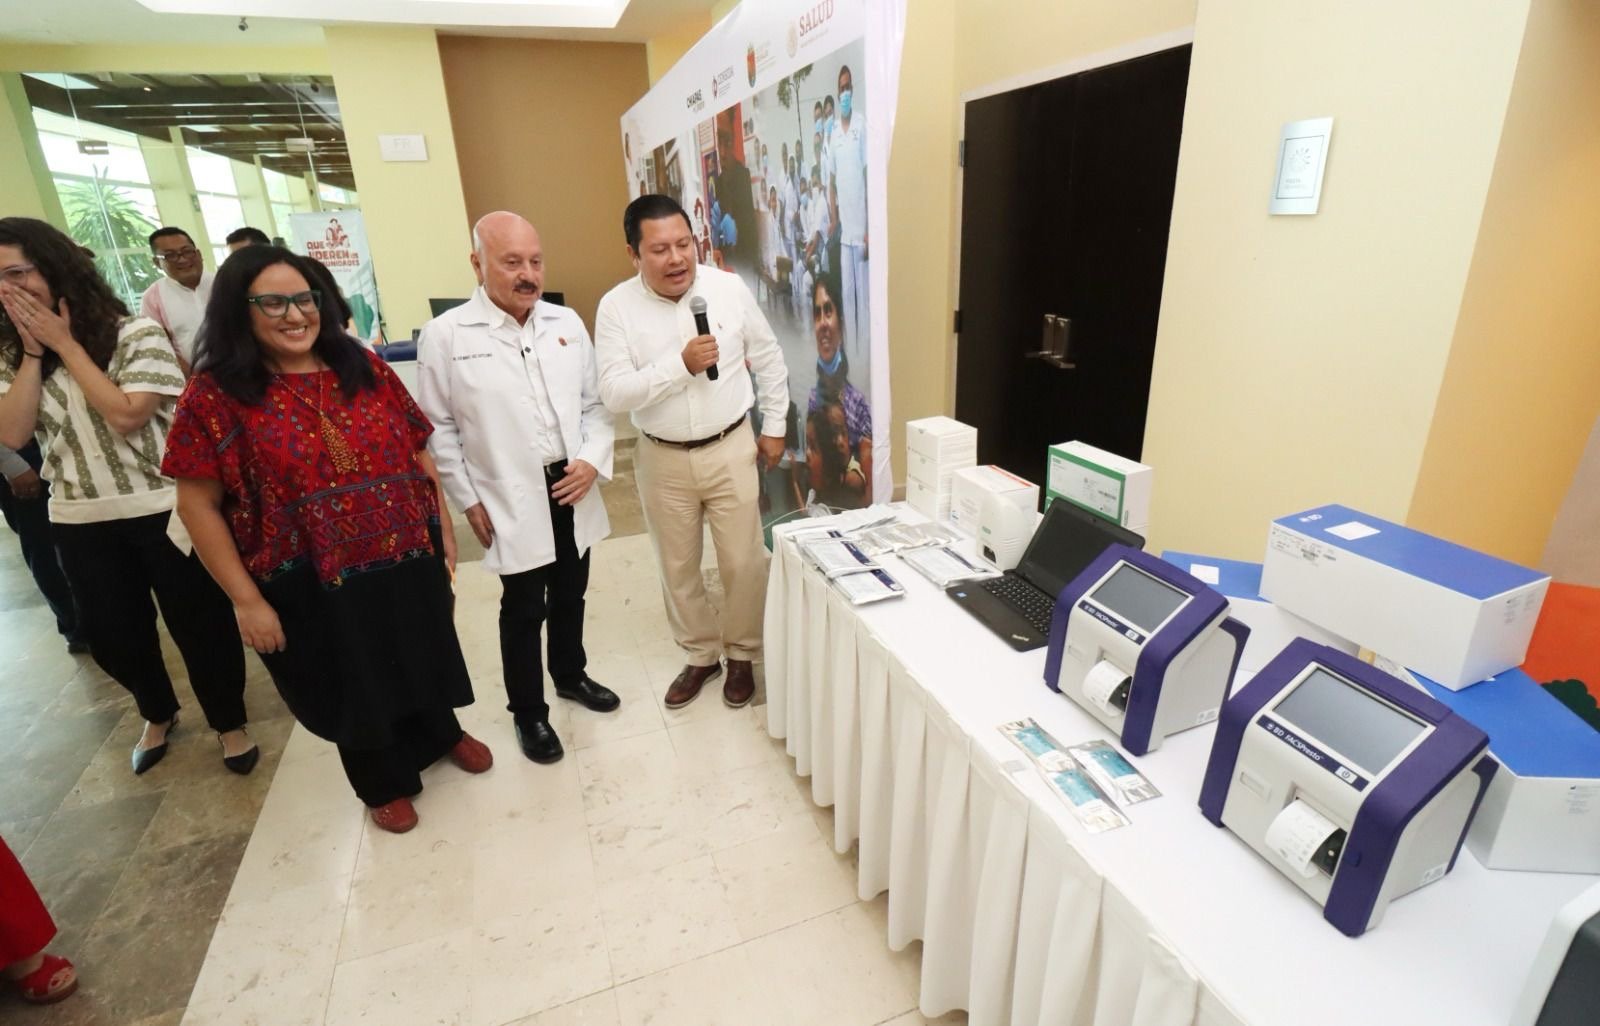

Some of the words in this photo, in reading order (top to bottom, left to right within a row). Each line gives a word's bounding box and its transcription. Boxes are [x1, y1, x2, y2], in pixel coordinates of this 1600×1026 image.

[799, 0, 834, 37] SALUD
[307, 241, 325, 249] QUE
[1273, 725, 1285, 737] BD
